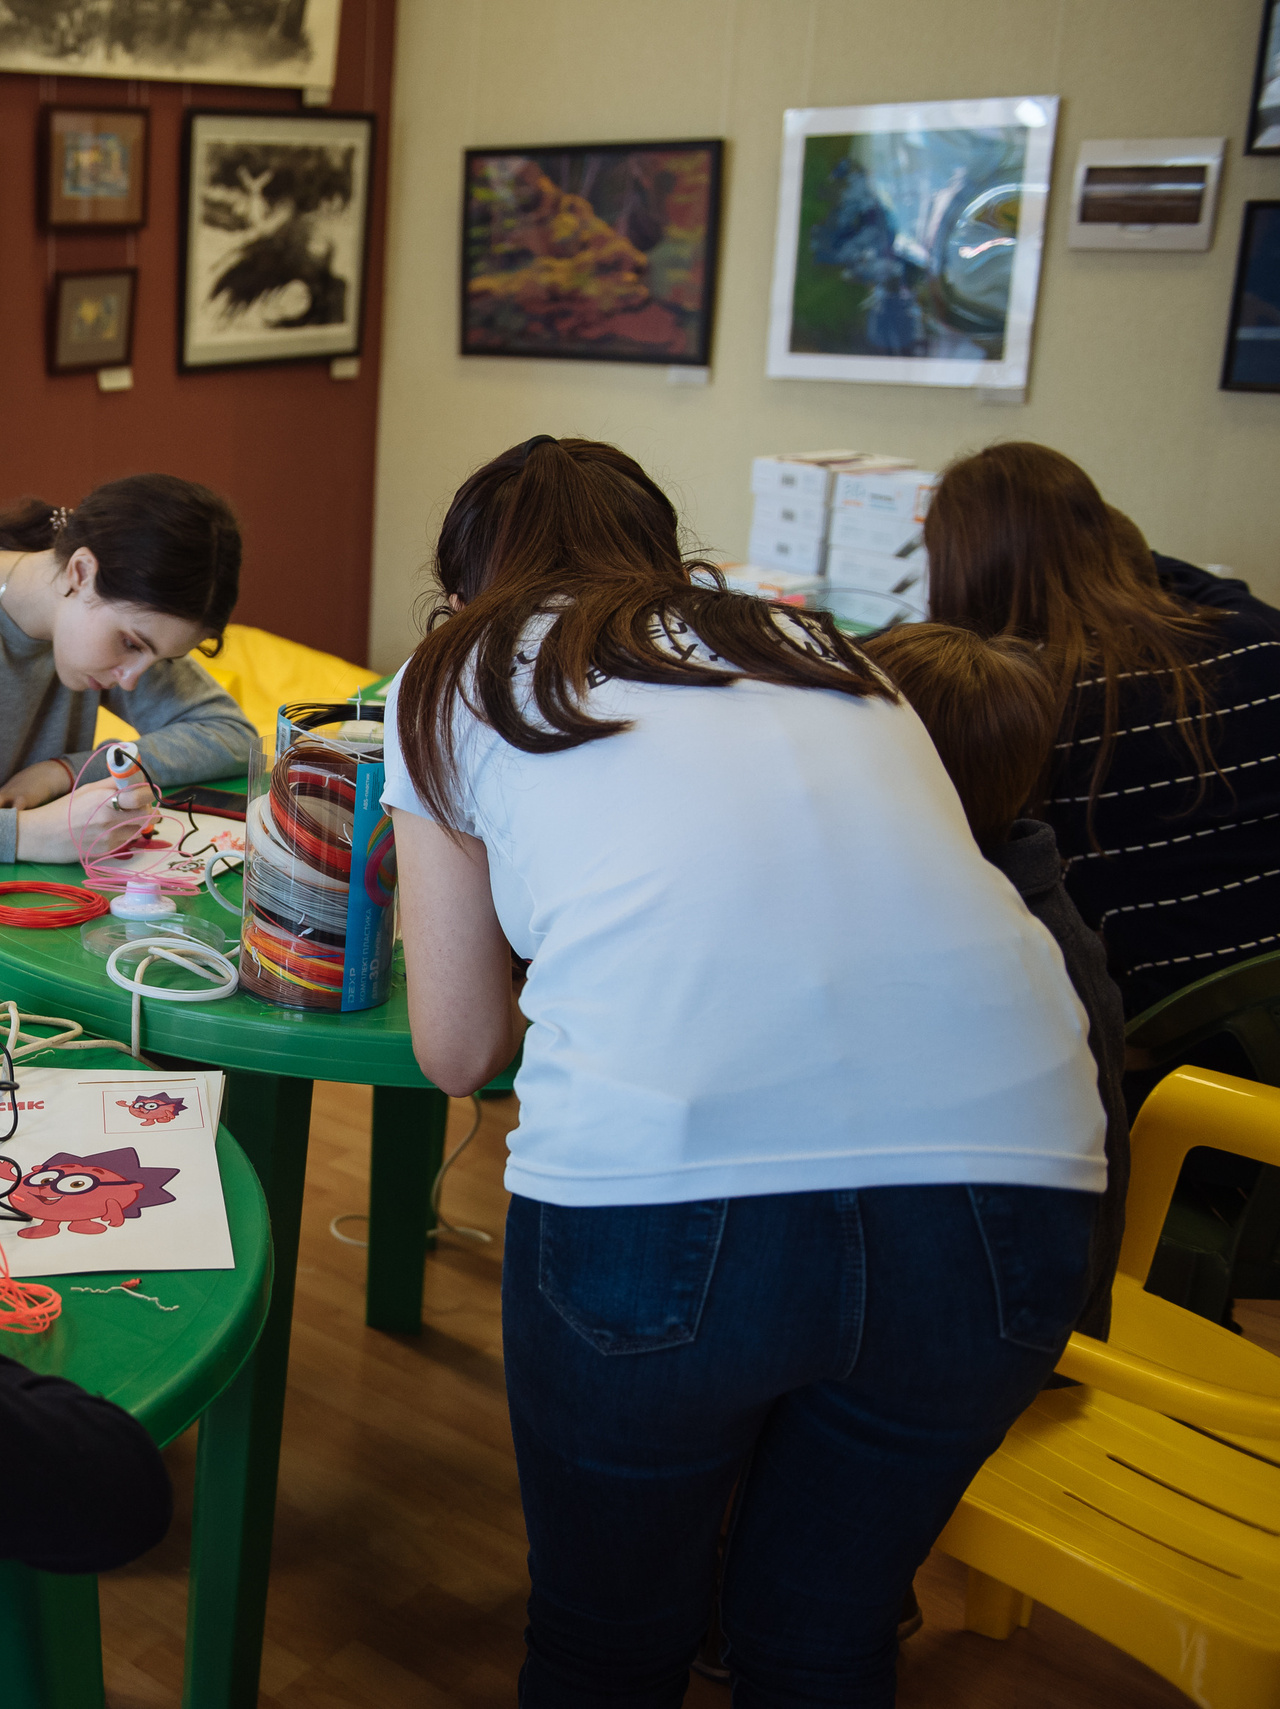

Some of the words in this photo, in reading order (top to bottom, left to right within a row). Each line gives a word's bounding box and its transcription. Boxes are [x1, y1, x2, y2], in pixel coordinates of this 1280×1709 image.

[363, 908, 373, 955] ПЛАСТИКА
[348, 967, 357, 1003] DEXP
[360, 957, 369, 1003] КОМПЛЕКТ
[369, 958, 380, 980] 3D
